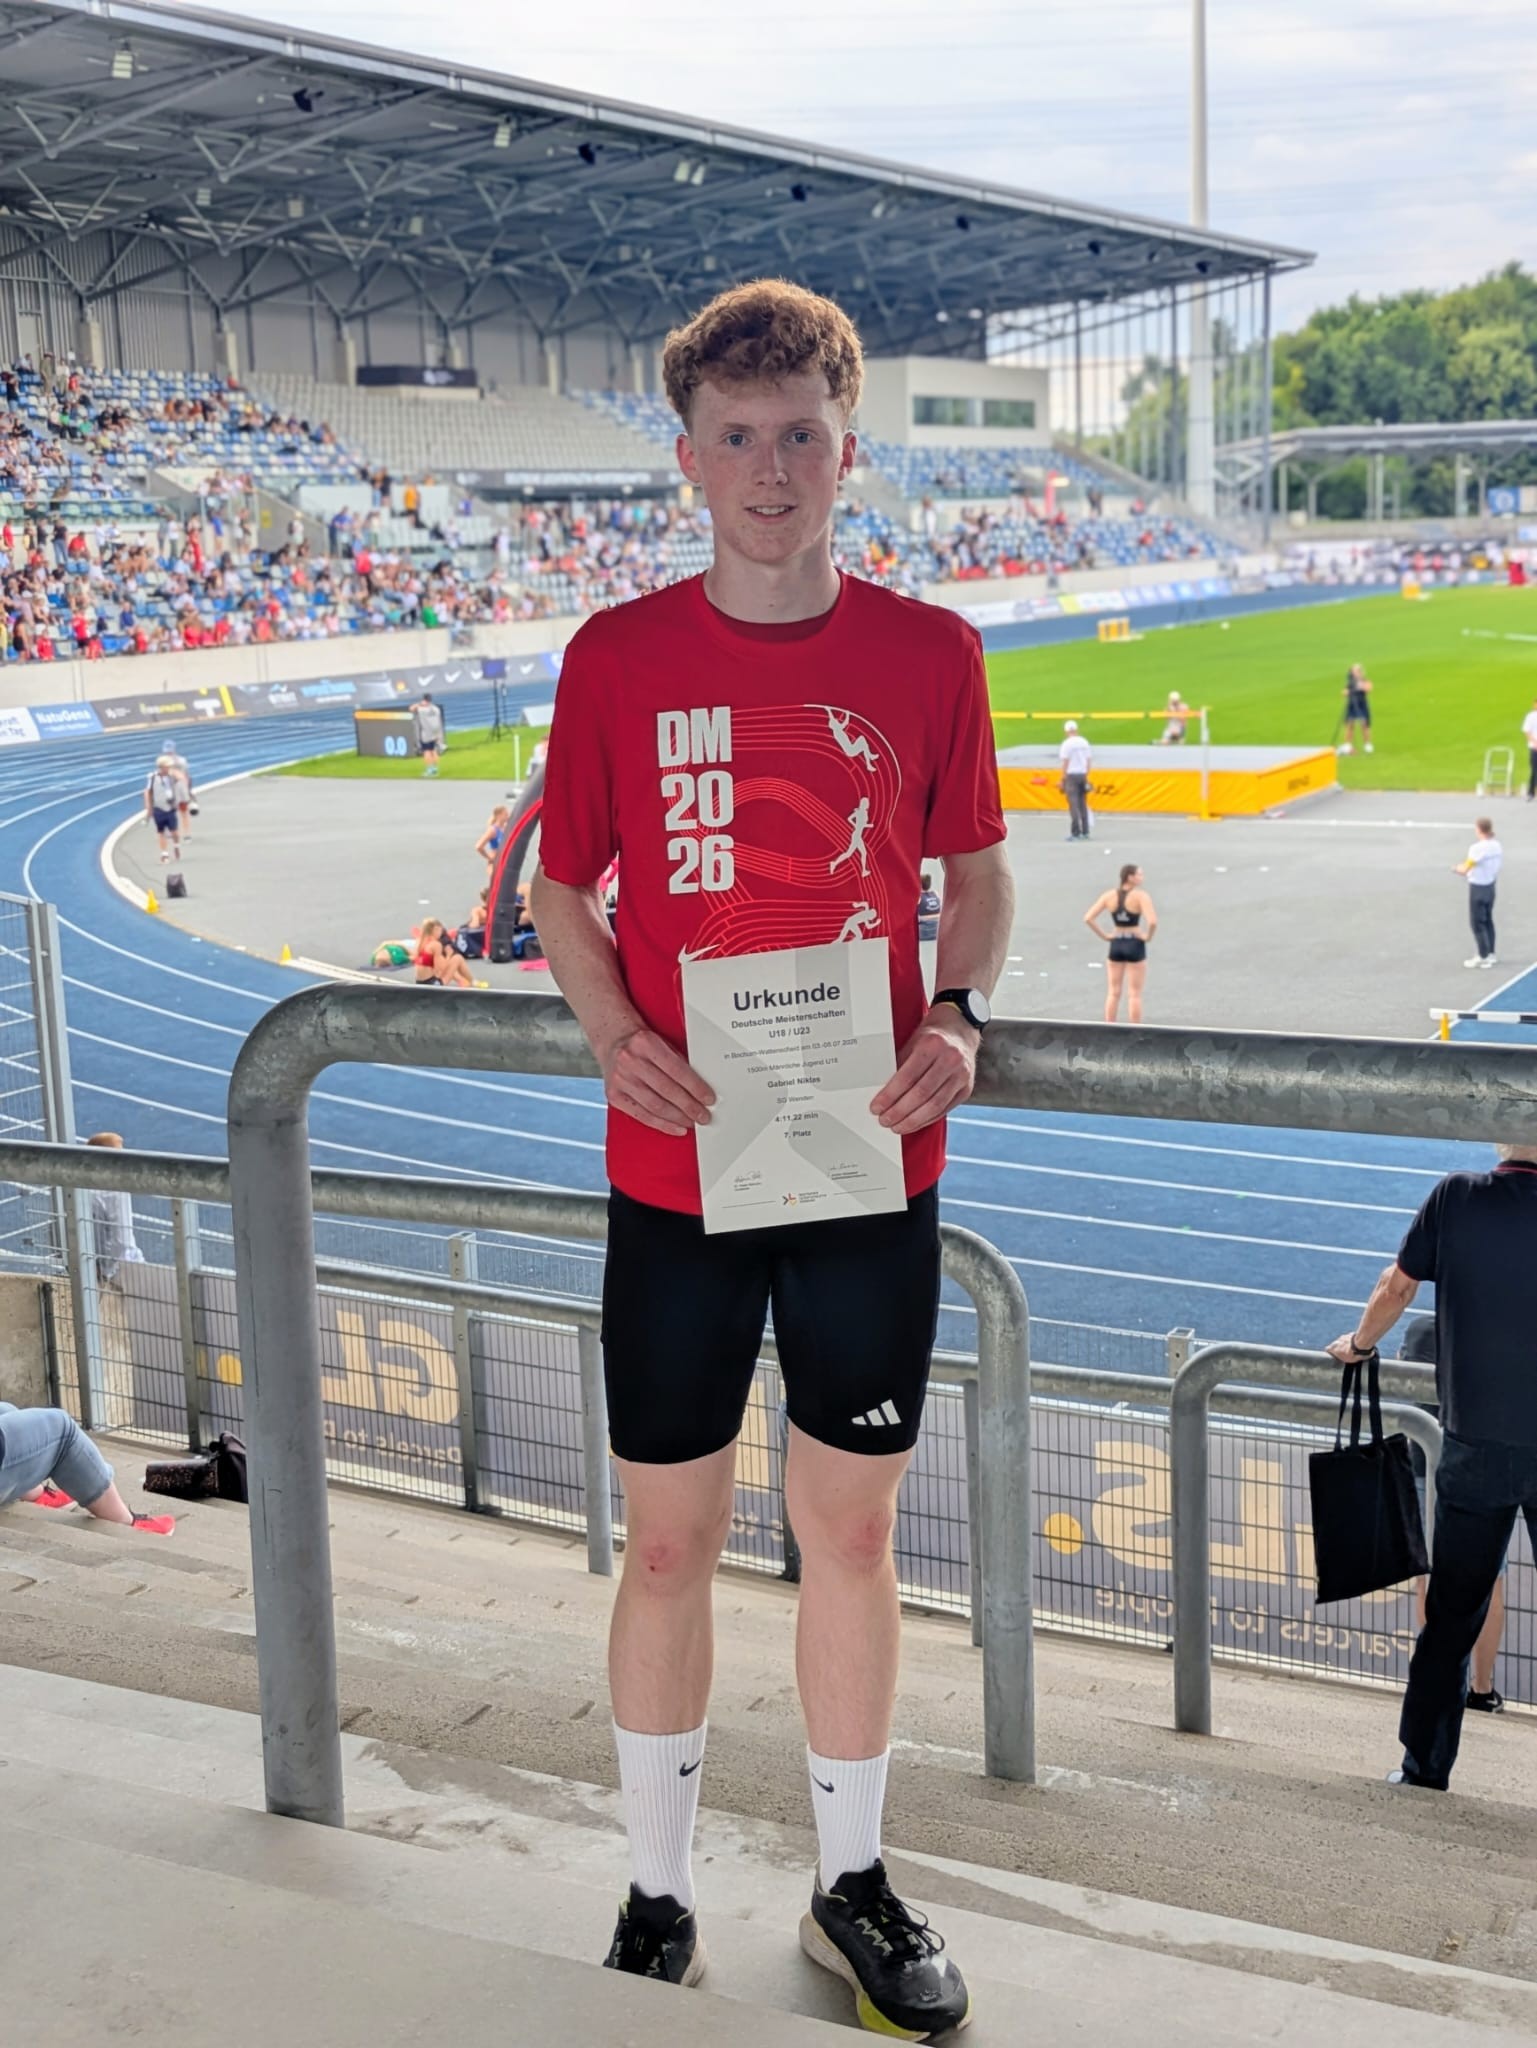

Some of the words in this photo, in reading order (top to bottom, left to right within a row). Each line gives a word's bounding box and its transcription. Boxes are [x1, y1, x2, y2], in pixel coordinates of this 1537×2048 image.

[657, 706, 732, 768] DM
[660, 770, 735, 832] 20
[667, 834, 735, 895] 26
[733, 981, 841, 1012] Urkunde
[731, 1017, 774, 1029] Deutsche
[775, 1008, 846, 1024] Meisterschaften
[768, 1029, 786, 1039] U18
[793, 1026, 811, 1037] U23
[767, 1078, 796, 1088] Gabriel
